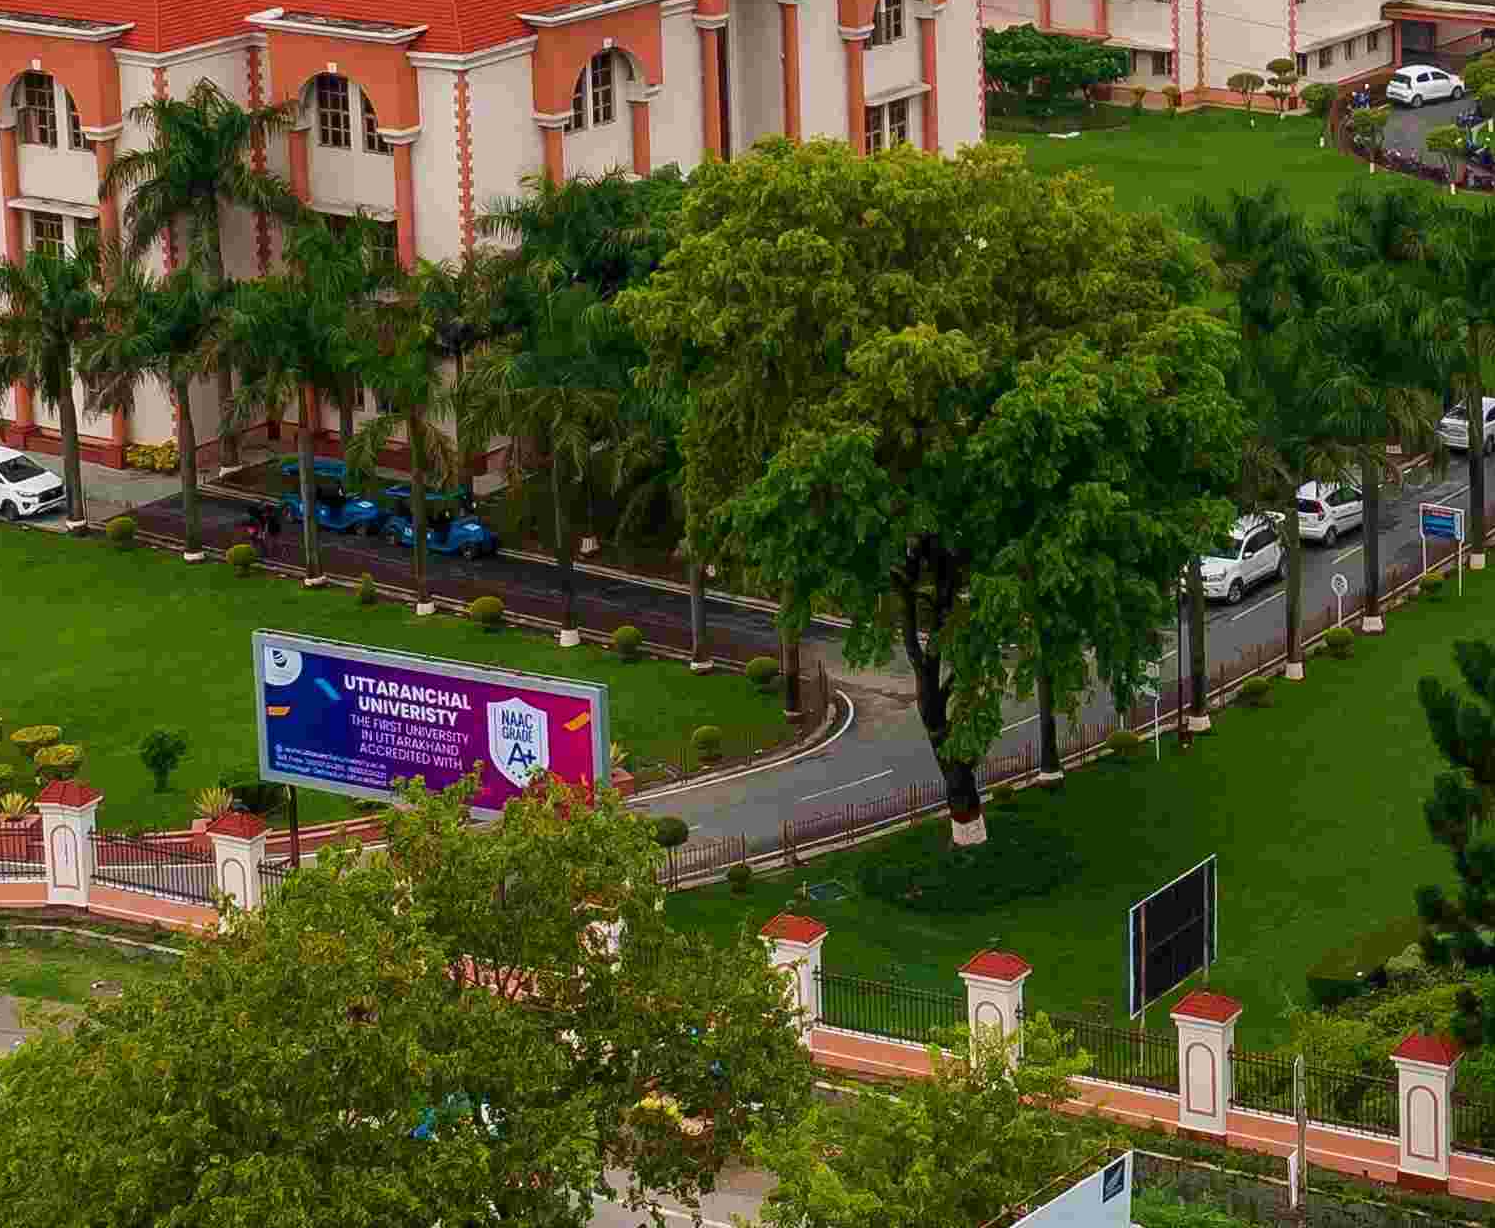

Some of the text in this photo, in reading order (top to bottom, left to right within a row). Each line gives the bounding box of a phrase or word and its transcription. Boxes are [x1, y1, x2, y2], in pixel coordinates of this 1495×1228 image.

[344, 674, 472, 710] UTTARANCHAL
[349, 714, 469, 745] THE FIRST UNIVERSITY
[502, 710, 533, 729] NAAC
[361, 729, 459, 757] IN UTTARAKHAND
[502, 726, 534, 743] GRADE
[359, 743, 431, 765] ACCREDITED
[433, 755, 464, 771] WITH
[507, 742, 537, 769] A+
